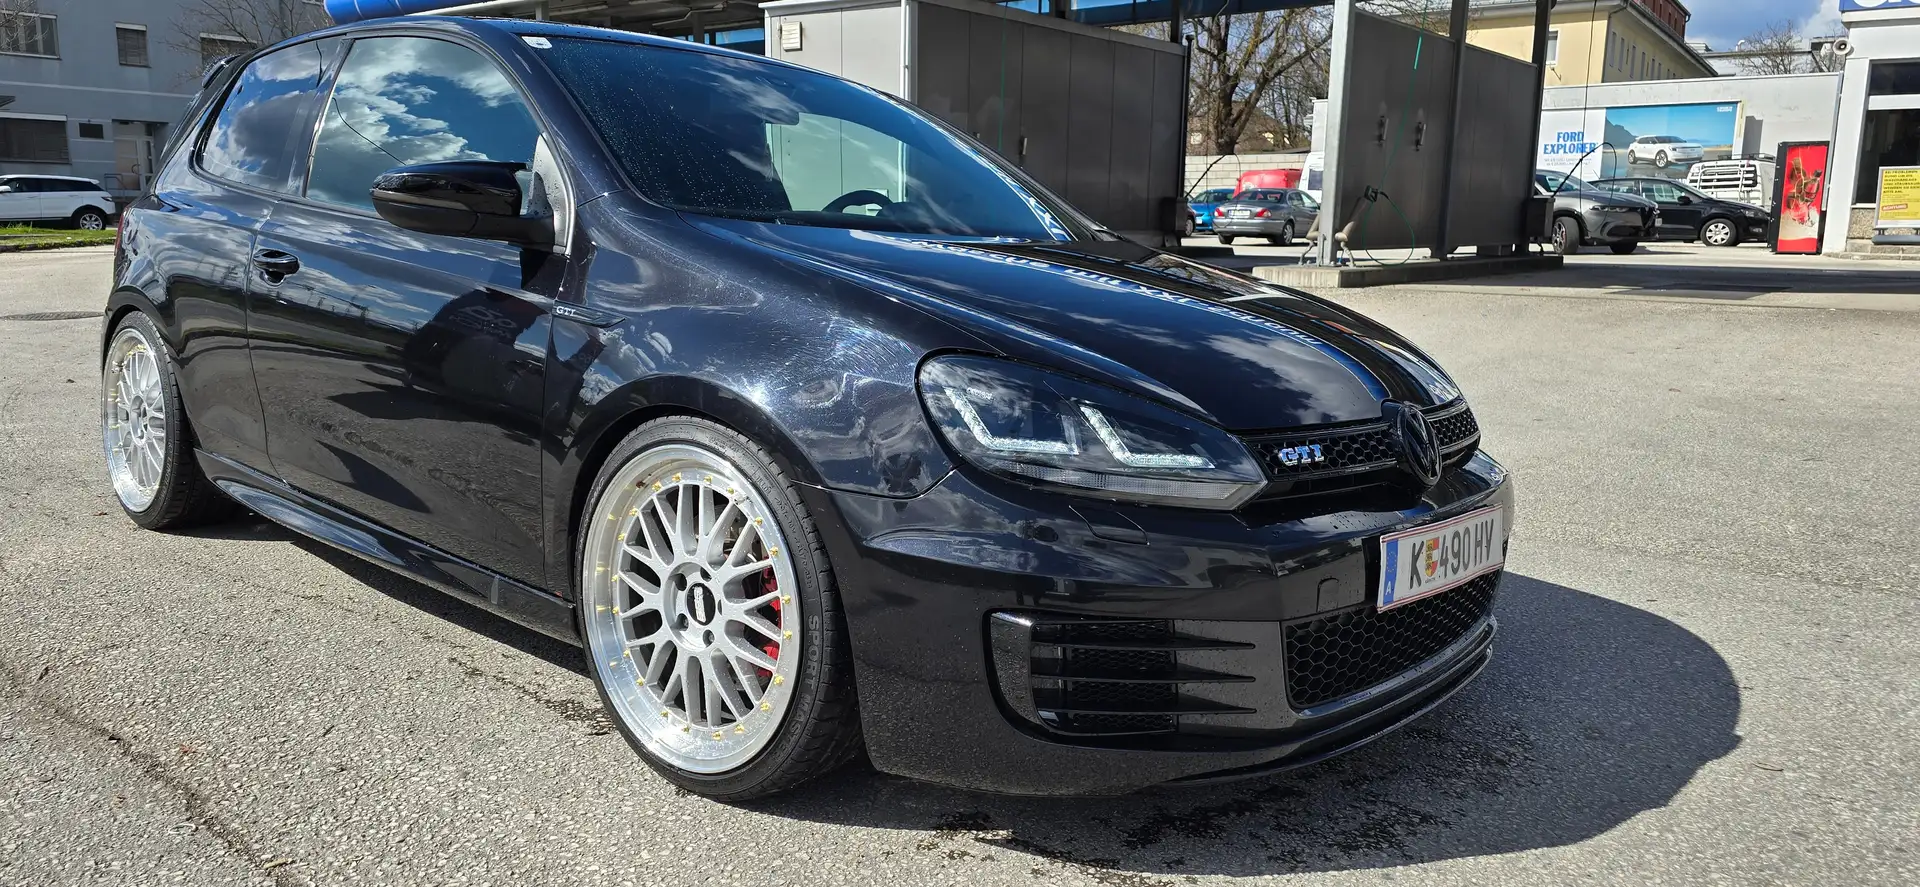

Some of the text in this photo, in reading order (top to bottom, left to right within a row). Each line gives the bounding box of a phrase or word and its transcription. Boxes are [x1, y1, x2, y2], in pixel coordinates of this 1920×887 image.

[1556, 132, 1584, 142] FORD
[1543, 143, 1597, 154] EXPLORER
[556, 306, 576, 317] GTI
[1278, 444, 1325, 467] GTI
[1409, 541, 1424, 589] K
[1385, 580, 1392, 596] A
[803, 614, 820, 690] SPORT
